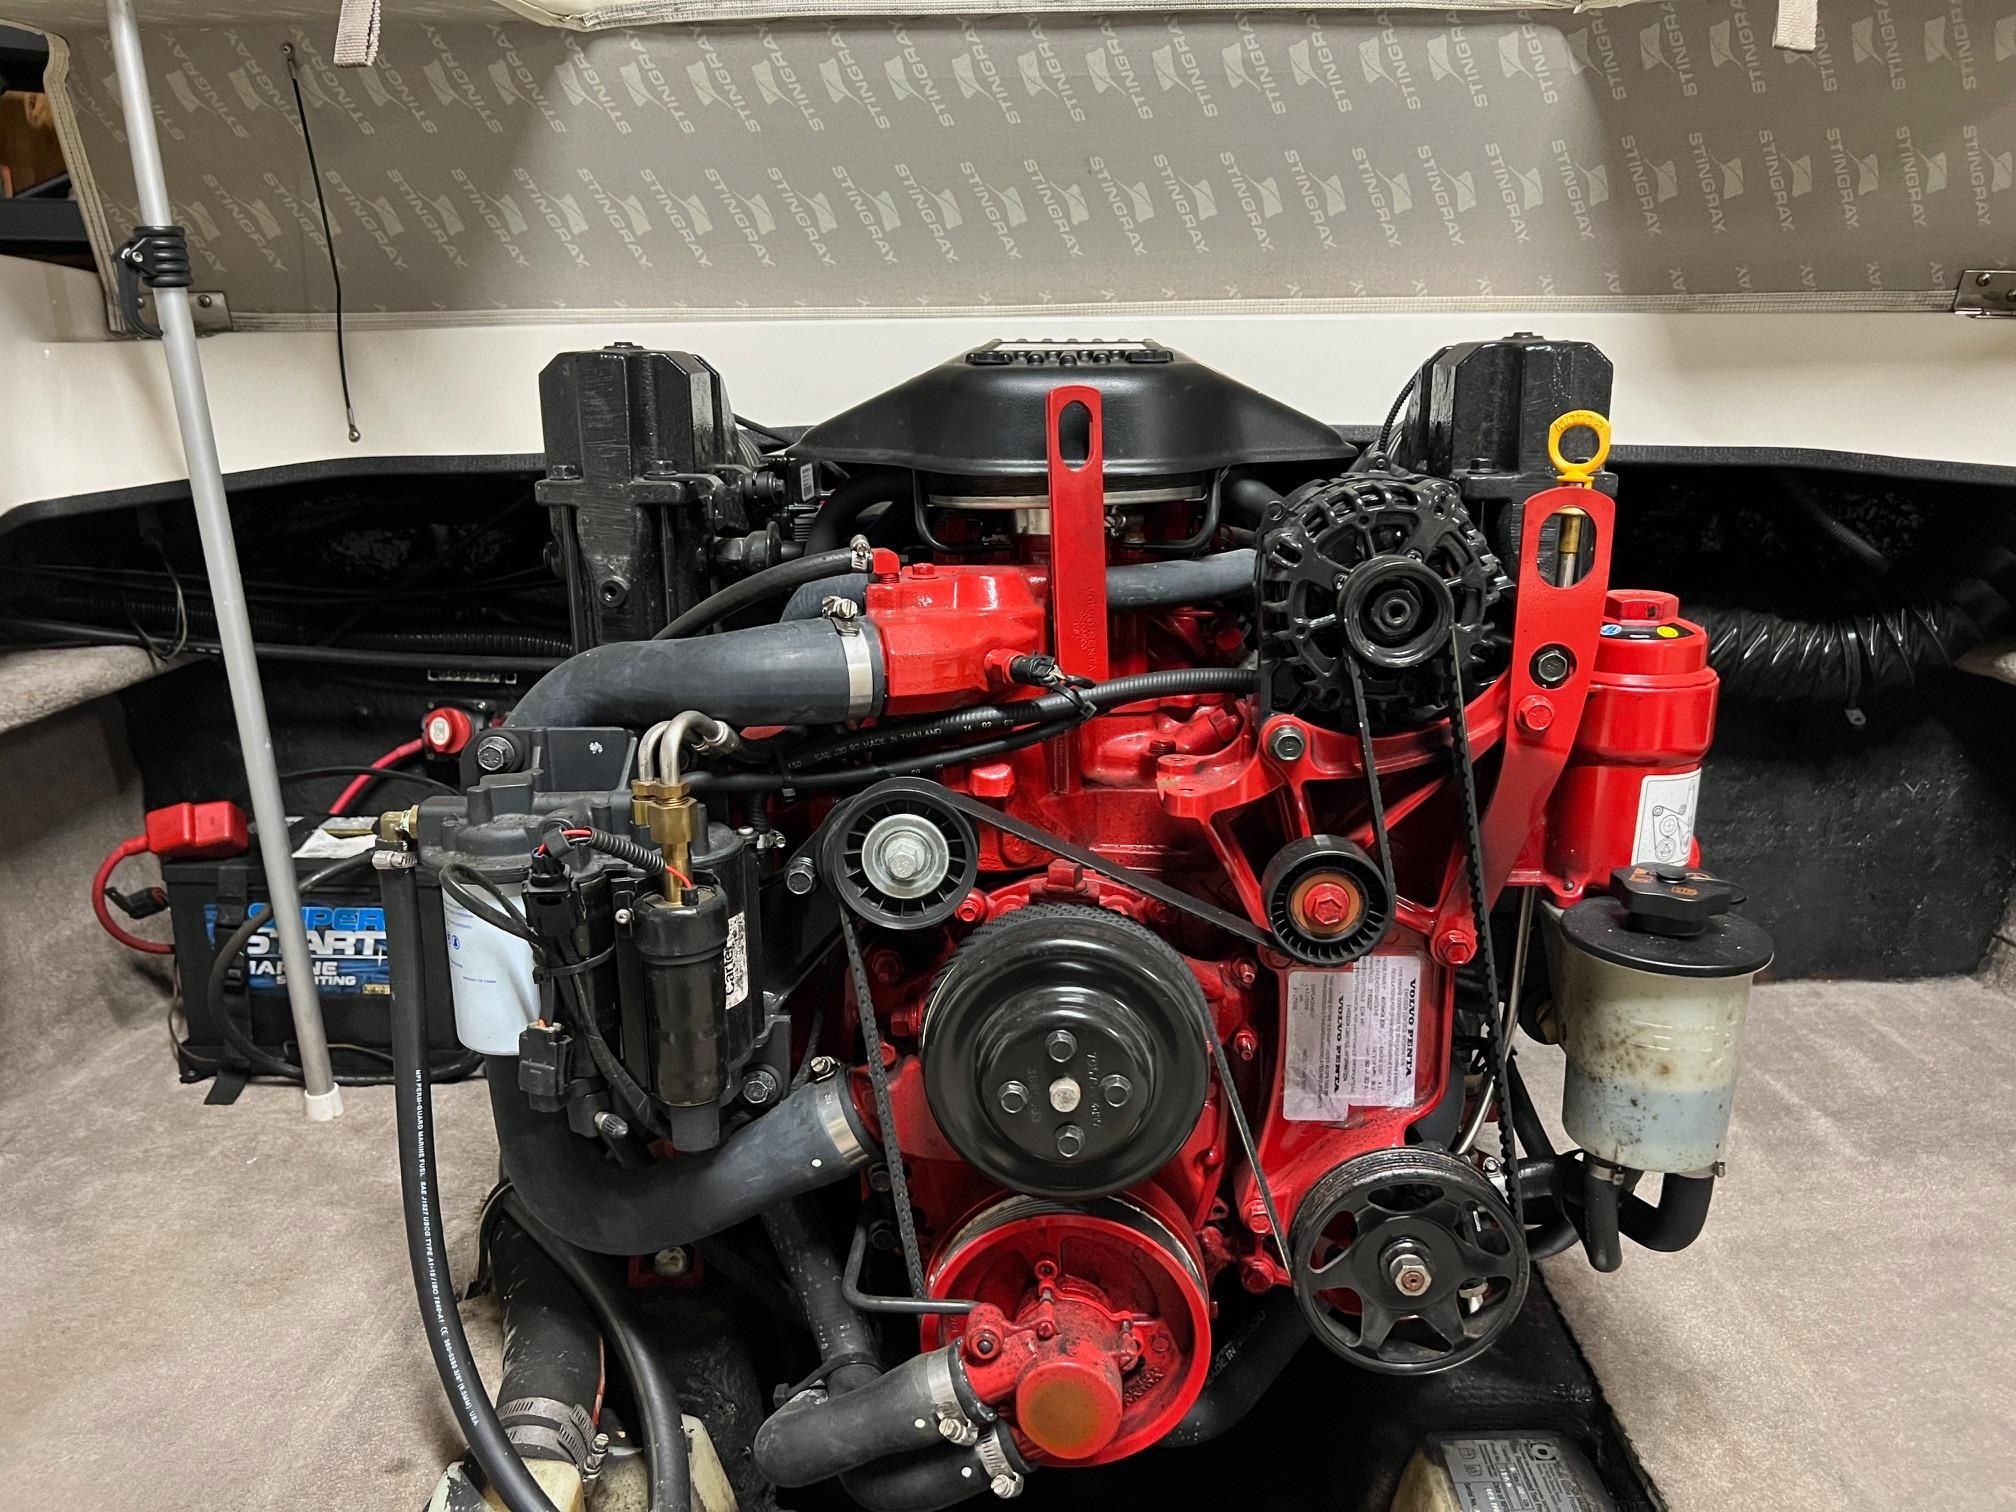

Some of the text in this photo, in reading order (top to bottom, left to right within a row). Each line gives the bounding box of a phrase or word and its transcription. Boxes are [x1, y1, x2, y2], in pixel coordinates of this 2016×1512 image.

[376, 53, 438, 135] STINGR
[418, 22, 504, 135] STINGRAY
[485, 23, 566, 134] STINGRAY
[689, 26, 762, 134] STINGRAY
[754, 23, 824, 132] STINGRAY
[822, 22, 891, 130] STINGRAY
[888, 19, 955, 128] STINGRAY
[956, 16, 1022, 126] STINGRAY
[1022, 14, 1087, 123] STINGRAY
[1303, 11, 1352, 113] STINGRA
[1376, 9, 1421, 111] STINGRA
[1444, 10, 1489, 109] STINGRA
[1516, 10, 1560, 106] STINGRA
[1659, 1, 1700, 98] STINGRA
[1729, 0, 1767, 95] STINGRA
[1815, 23, 1839, 92] STING
[200, 172, 291, 273] STINGRAY
[325, 167, 408, 271] STINGRAY
[387, 167, 469, 268] STINGRAY
[449, 167, 531, 268] STINGRAY
[512, 167, 591, 268] STINGRAY
[577, 166, 654, 268] STINGRAY
[640, 167, 713, 268] STINGRAY
[704, 167, 777, 268] STINGRAY
[767, 166, 837, 267] STINGRAY
[832, 164, 900, 265] STINGRAY
[895, 162, 961, 262] STINGRAY
[959, 160, 1023, 260] STINGRAY
[1023, 158, 1085, 258] STINGRAY
[1089, 155, 1149, 257] STINGRAY
[1153, 152, 1213, 255] STINGRAY
[1219, 150, 1275, 254] STINGRAY
[1284, 149, 1338, 250] STINGRAY
[1352, 146, 1402, 249] STINGRAY
[1417, 144, 1466, 247] STINGRAY
[1484, 141, 1532, 244] STINGRAY
[1551, 138, 1596, 240] STINGRAY
[1620, 135, 1661, 237] STINGRAY
[1688, 131, 1728, 235] STINGRAY
[1758, 129, 1797, 232] STINGRAY
[1826, 127, 1861, 231] STINGRAY
[1895, 125, 1928, 230] STINGRAY
[1962, 124, 1993, 226] STINGRAY
[901, 727, 942, 740] THAILAND
[248, 902, 386, 930] SPER
[1334, 995, 1344, 1094] VOLVO PENTA
[1406, 978, 1416, 1077] VOLVO PENTA
[416, 1083, 424, 1130] PERM-GUARD
[421, 1196, 429, 1215] J1527
[423, 1216, 431, 1236] USCG
[425, 1238, 434, 1256] TYPE
[427, 1257, 436, 1277] A1-15
[469, 1412, 479, 1426] USA
